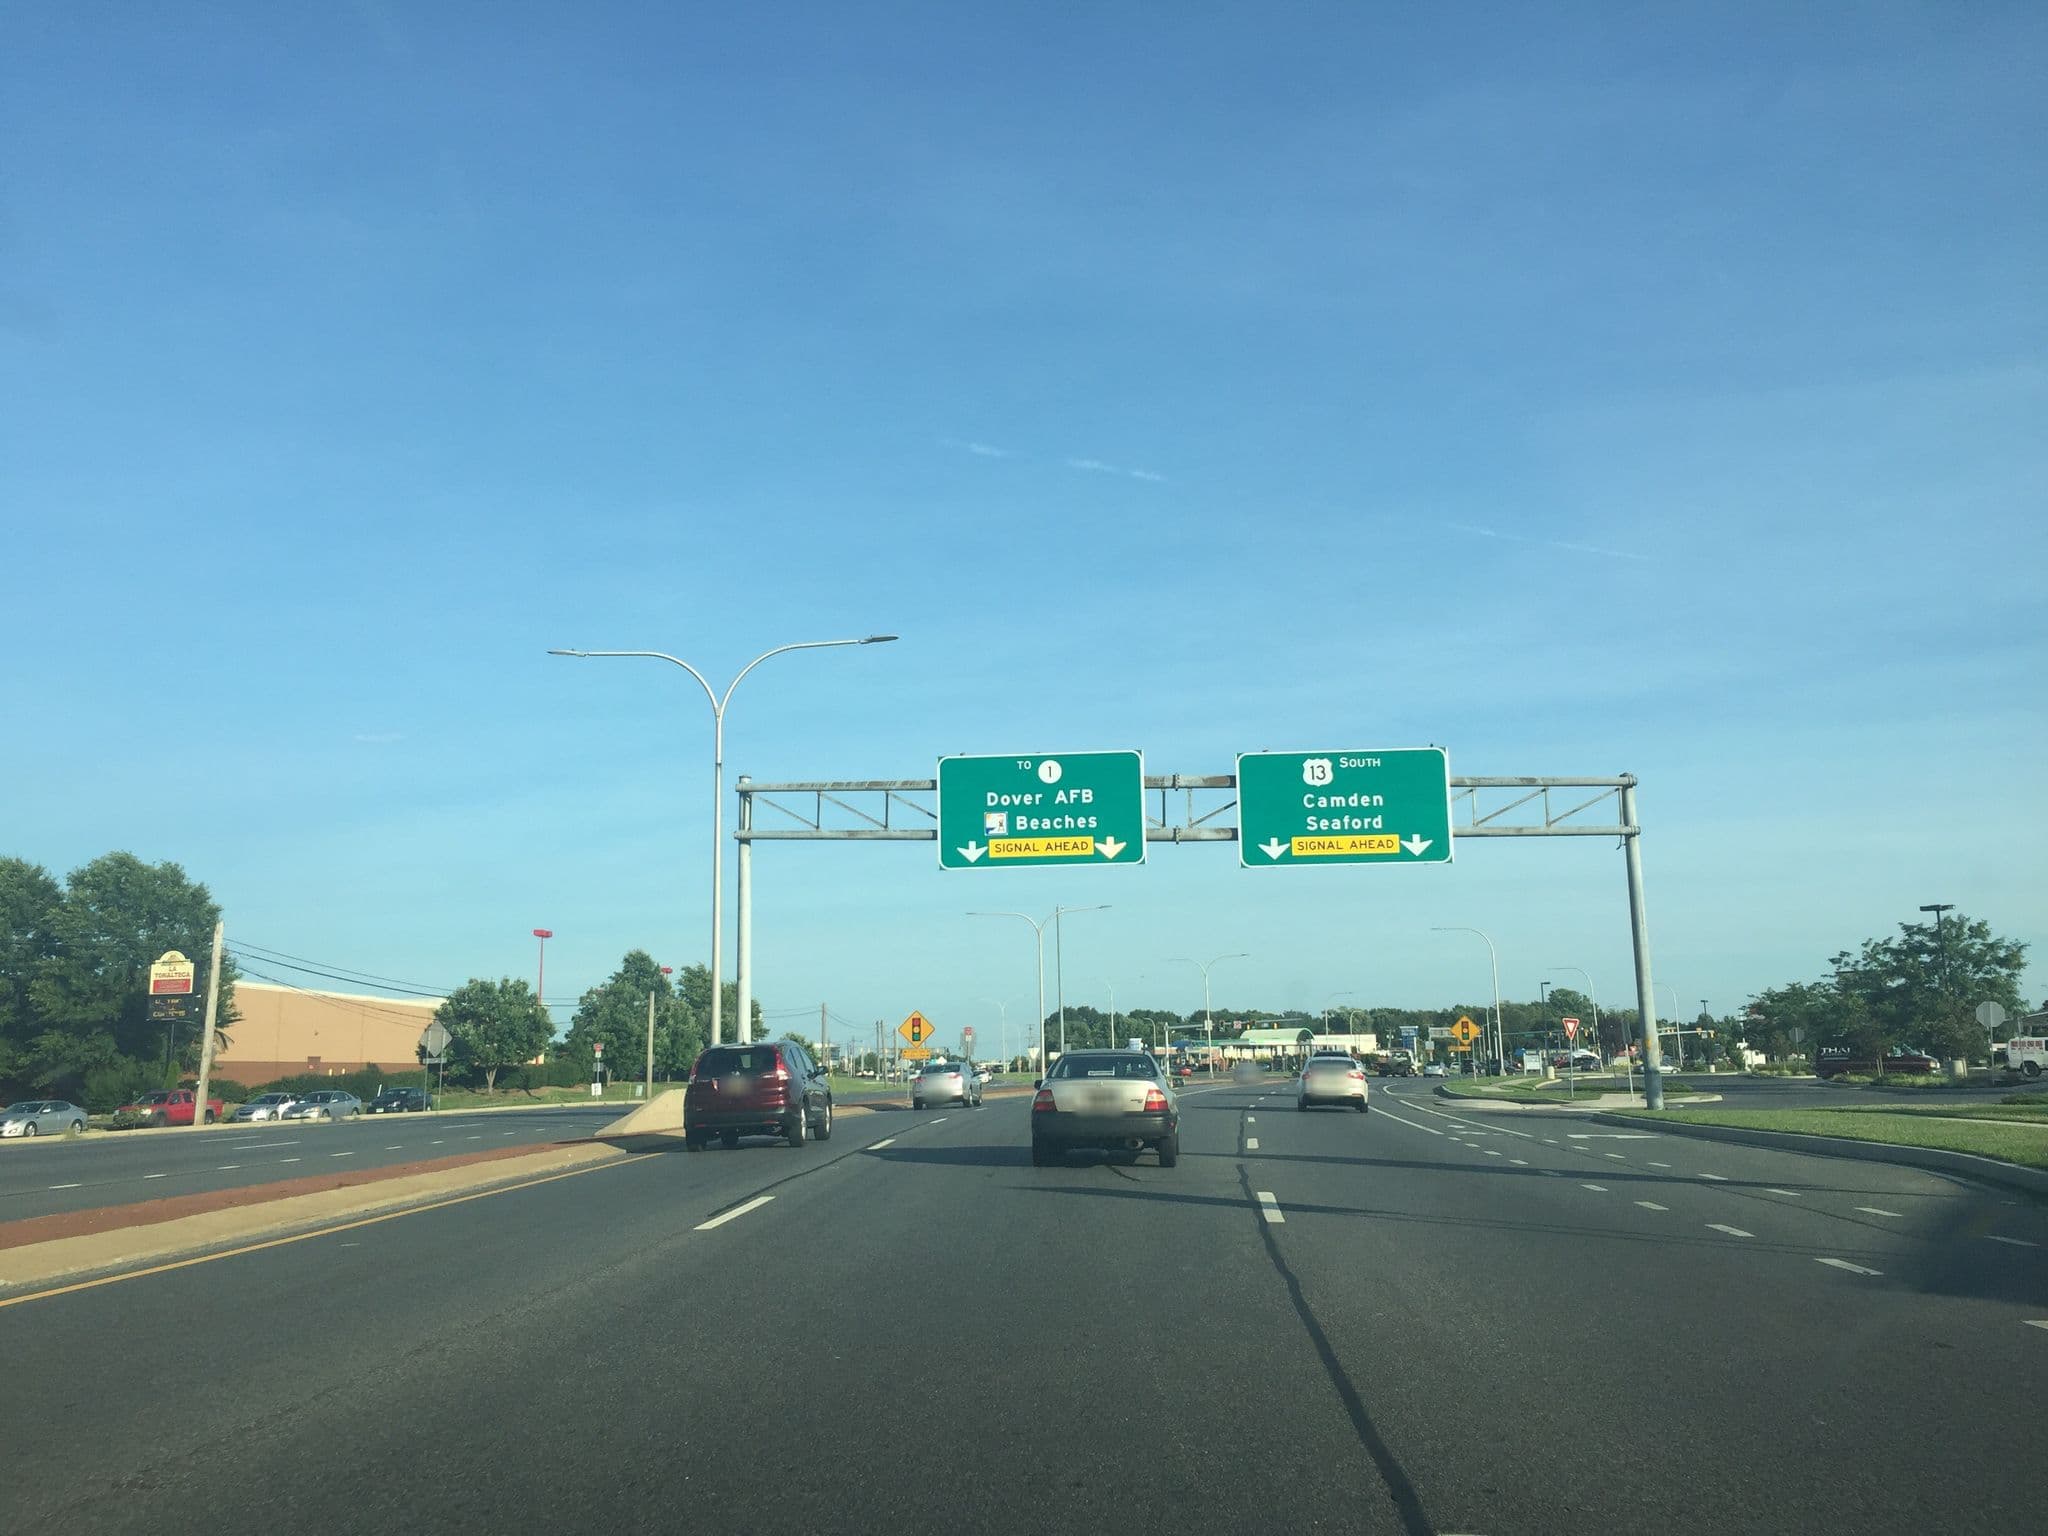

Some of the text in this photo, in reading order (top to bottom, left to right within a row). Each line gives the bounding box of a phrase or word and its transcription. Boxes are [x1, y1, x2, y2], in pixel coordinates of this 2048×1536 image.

[1017, 761, 1052, 778] TO 1
[1310, 757, 1381, 781] 13 SOUTH
[987, 789, 1093, 806] Dover AFB
[1303, 793, 1384, 808] Camden
[1016, 815, 1098, 830] Beaches
[1306, 814, 1382, 830] Seaford
[995, 840, 1088, 853] SIGNAL AHEAD
[1297, 839, 1393, 851] SIGNAL AHEAD
